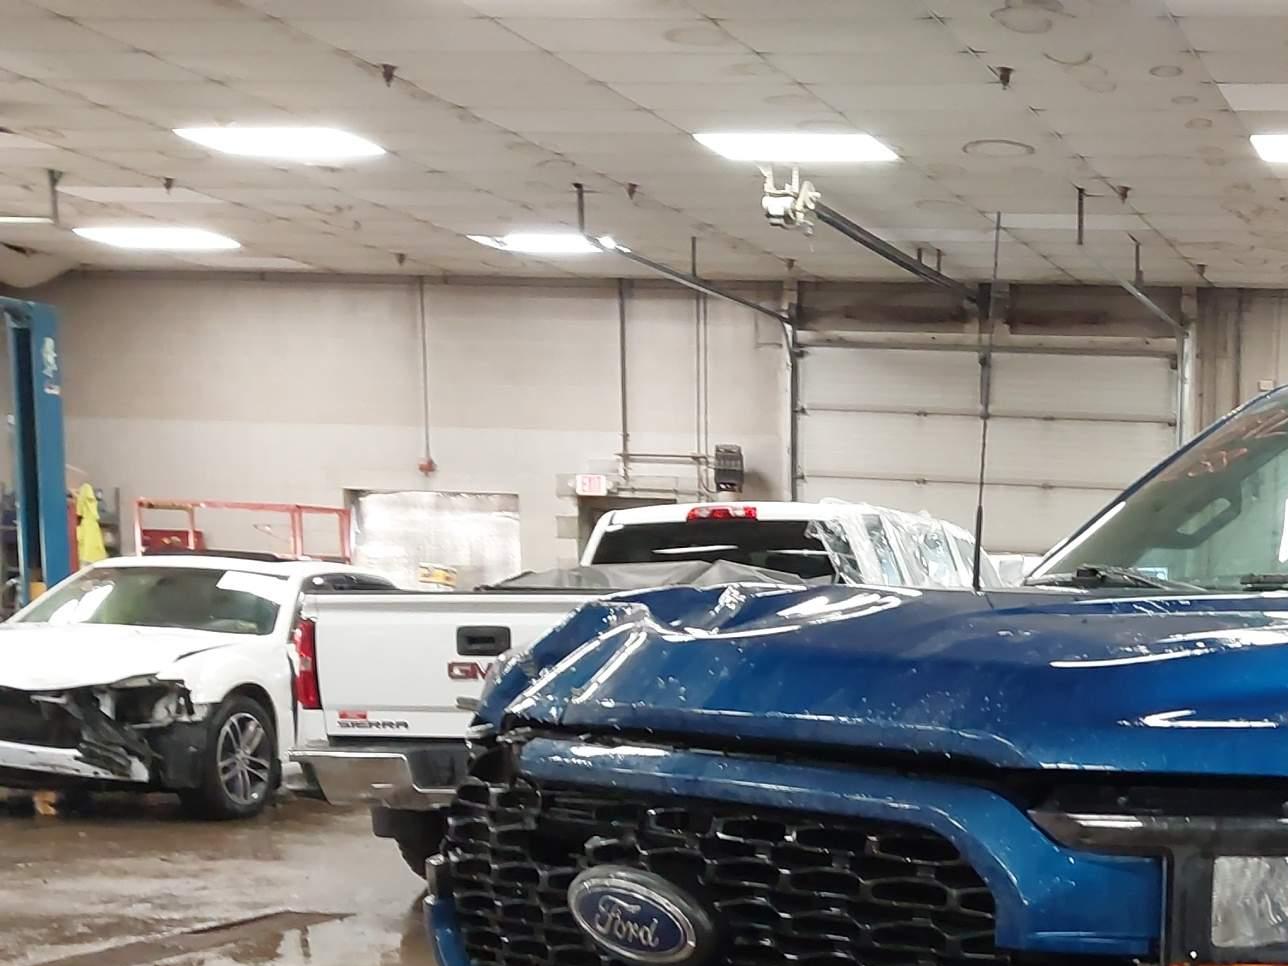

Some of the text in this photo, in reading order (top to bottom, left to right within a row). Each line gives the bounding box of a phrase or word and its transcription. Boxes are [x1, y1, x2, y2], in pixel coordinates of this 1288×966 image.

[447, 661, 493, 680] GM
[336, 720, 409, 729] SIERRA
[594, 894, 660, 948] Ford
